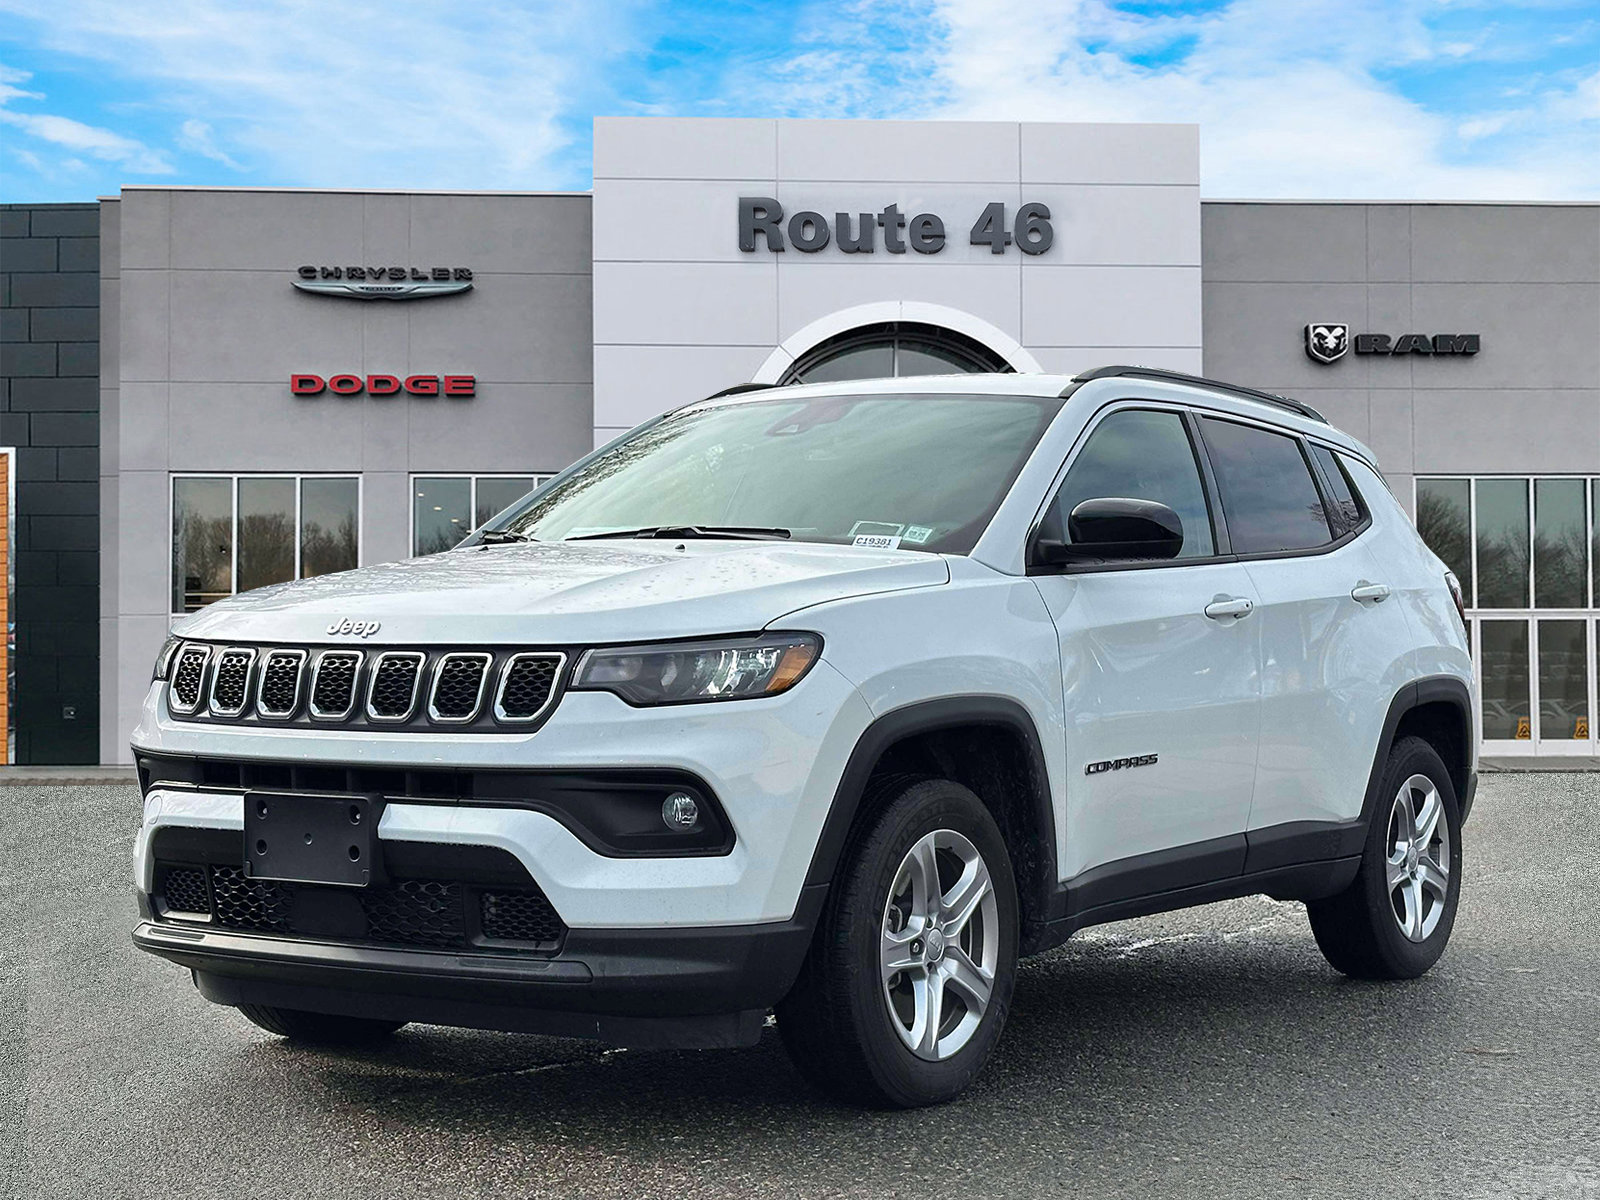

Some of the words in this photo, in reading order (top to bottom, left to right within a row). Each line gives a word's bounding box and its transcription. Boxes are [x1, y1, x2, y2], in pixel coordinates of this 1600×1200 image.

[738, 197, 946, 254] Route
[970, 202, 1054, 255] 46
[298, 266, 473, 281] CHRYSLER
[1354, 334, 1481, 356] RAM
[291, 374, 476, 397] DODGE
[326, 616, 381, 639] Jeep
[1085, 753, 1159, 776] COMPASS
